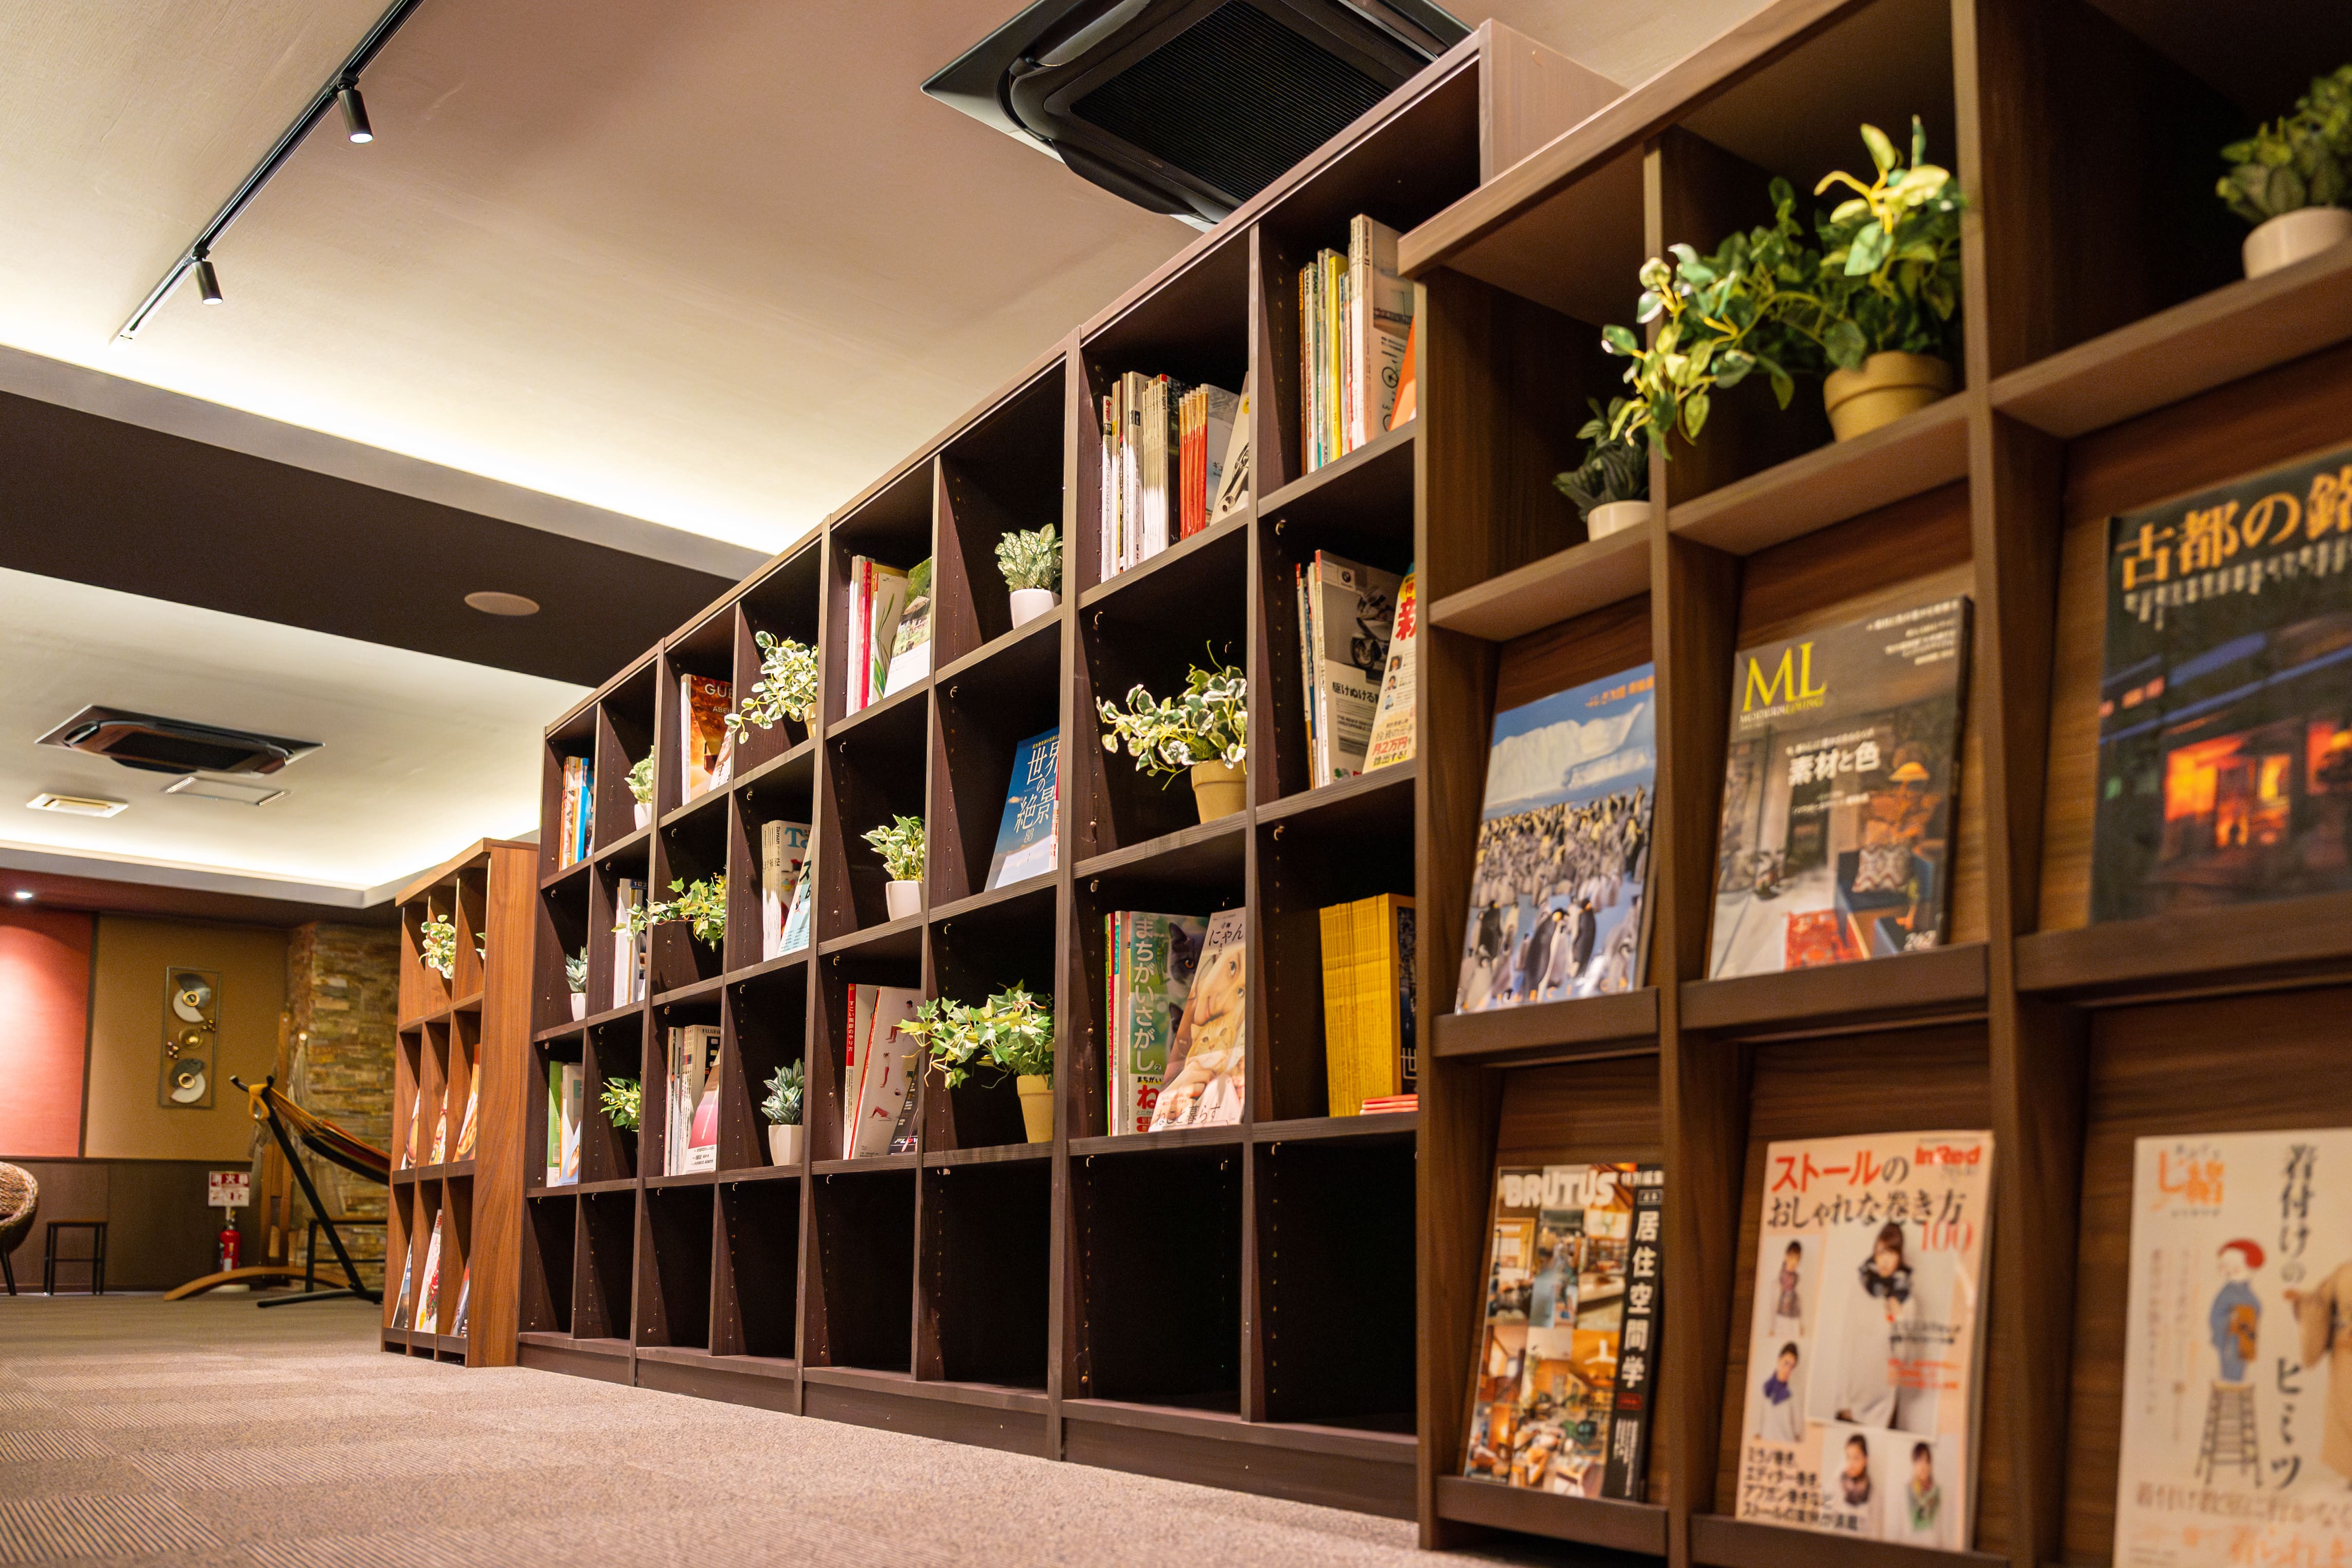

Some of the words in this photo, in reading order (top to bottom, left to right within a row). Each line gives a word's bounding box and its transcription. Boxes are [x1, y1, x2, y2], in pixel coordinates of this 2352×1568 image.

[1743, 642, 1827, 712] ML
[1788, 740, 1881, 787] 素材と色
[1134, 920, 1156, 1072] まちがいさがし
[1503, 1170, 1618, 1208] BRUTUS
[1771, 1150, 1910, 1193] ストールの
[1767, 1188, 1966, 1229] おしゃれな巻き方
[1920, 1220, 1974, 1254] 100
[1620, 1210, 1660, 1388] 居住空間学
